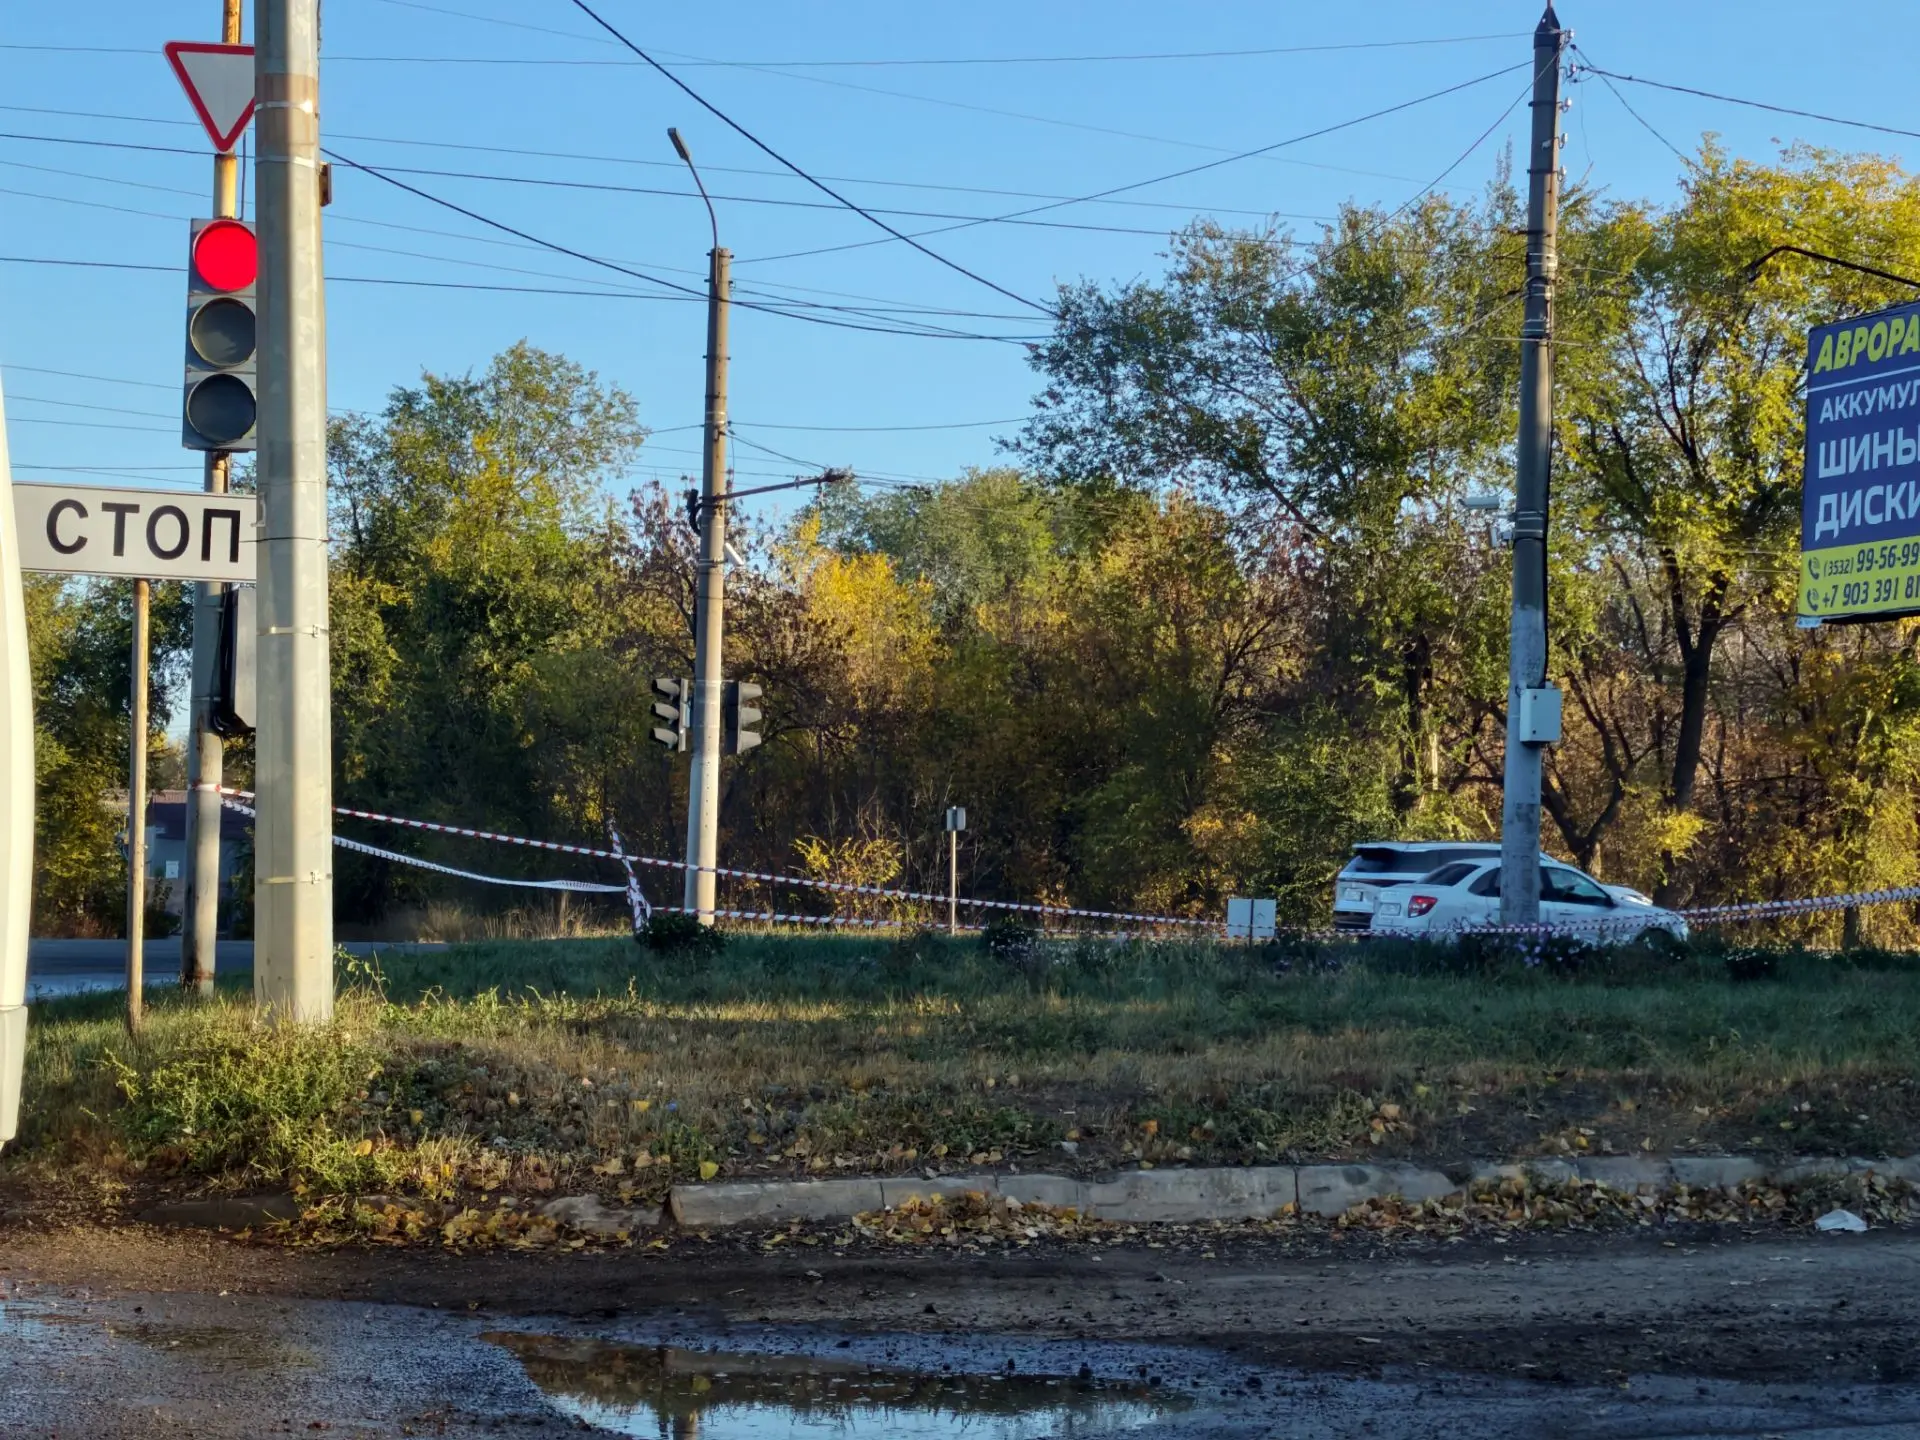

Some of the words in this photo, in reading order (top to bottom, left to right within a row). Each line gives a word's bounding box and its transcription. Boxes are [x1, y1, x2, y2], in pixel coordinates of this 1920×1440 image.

[1813, 314, 1920, 374] АВРОРА
[46, 499, 241, 563] СТОП
[1822, 584, 1839, 608] +7
[1842, 581, 1869, 606] 903
[1873, 577, 1899, 603] 391
